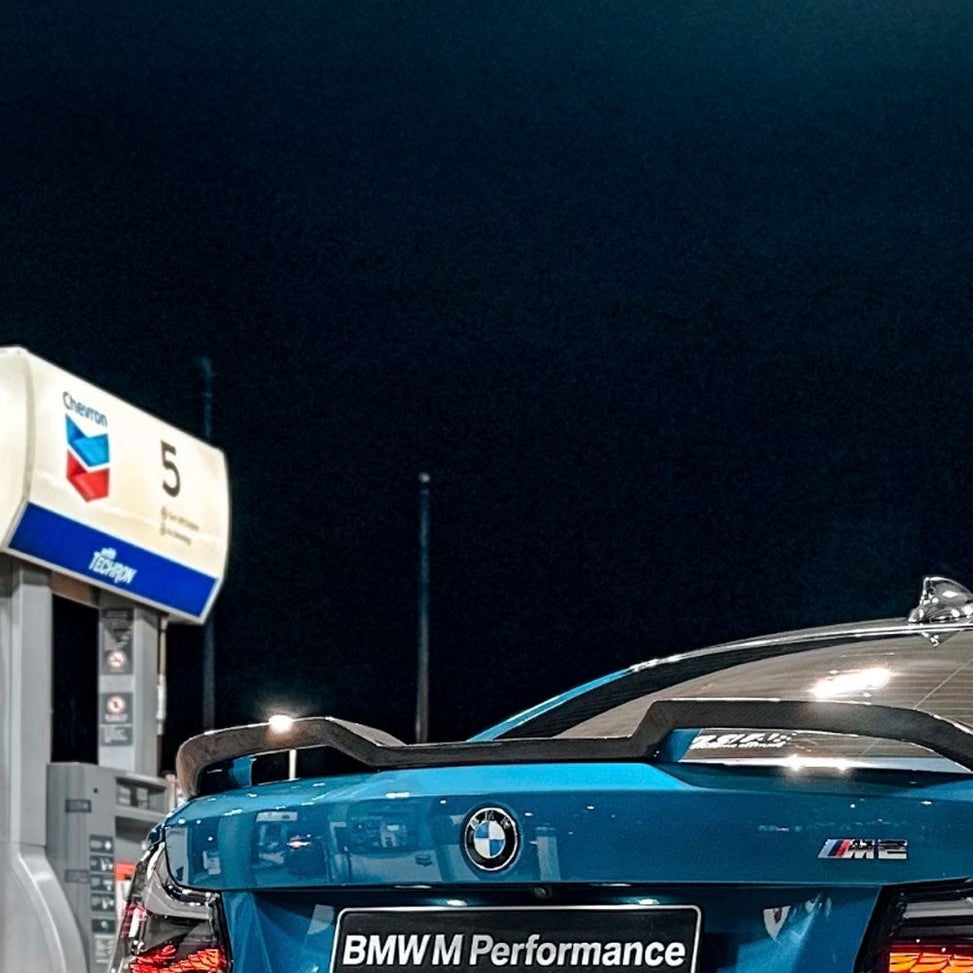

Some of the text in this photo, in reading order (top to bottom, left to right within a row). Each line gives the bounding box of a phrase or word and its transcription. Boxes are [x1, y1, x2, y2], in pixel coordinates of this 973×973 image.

[62, 391, 108, 427] Chevron
[160, 439, 181, 497] 5
[89, 551, 138, 584] TECHRON
[342, 934, 686, 966] BMW M Performance
